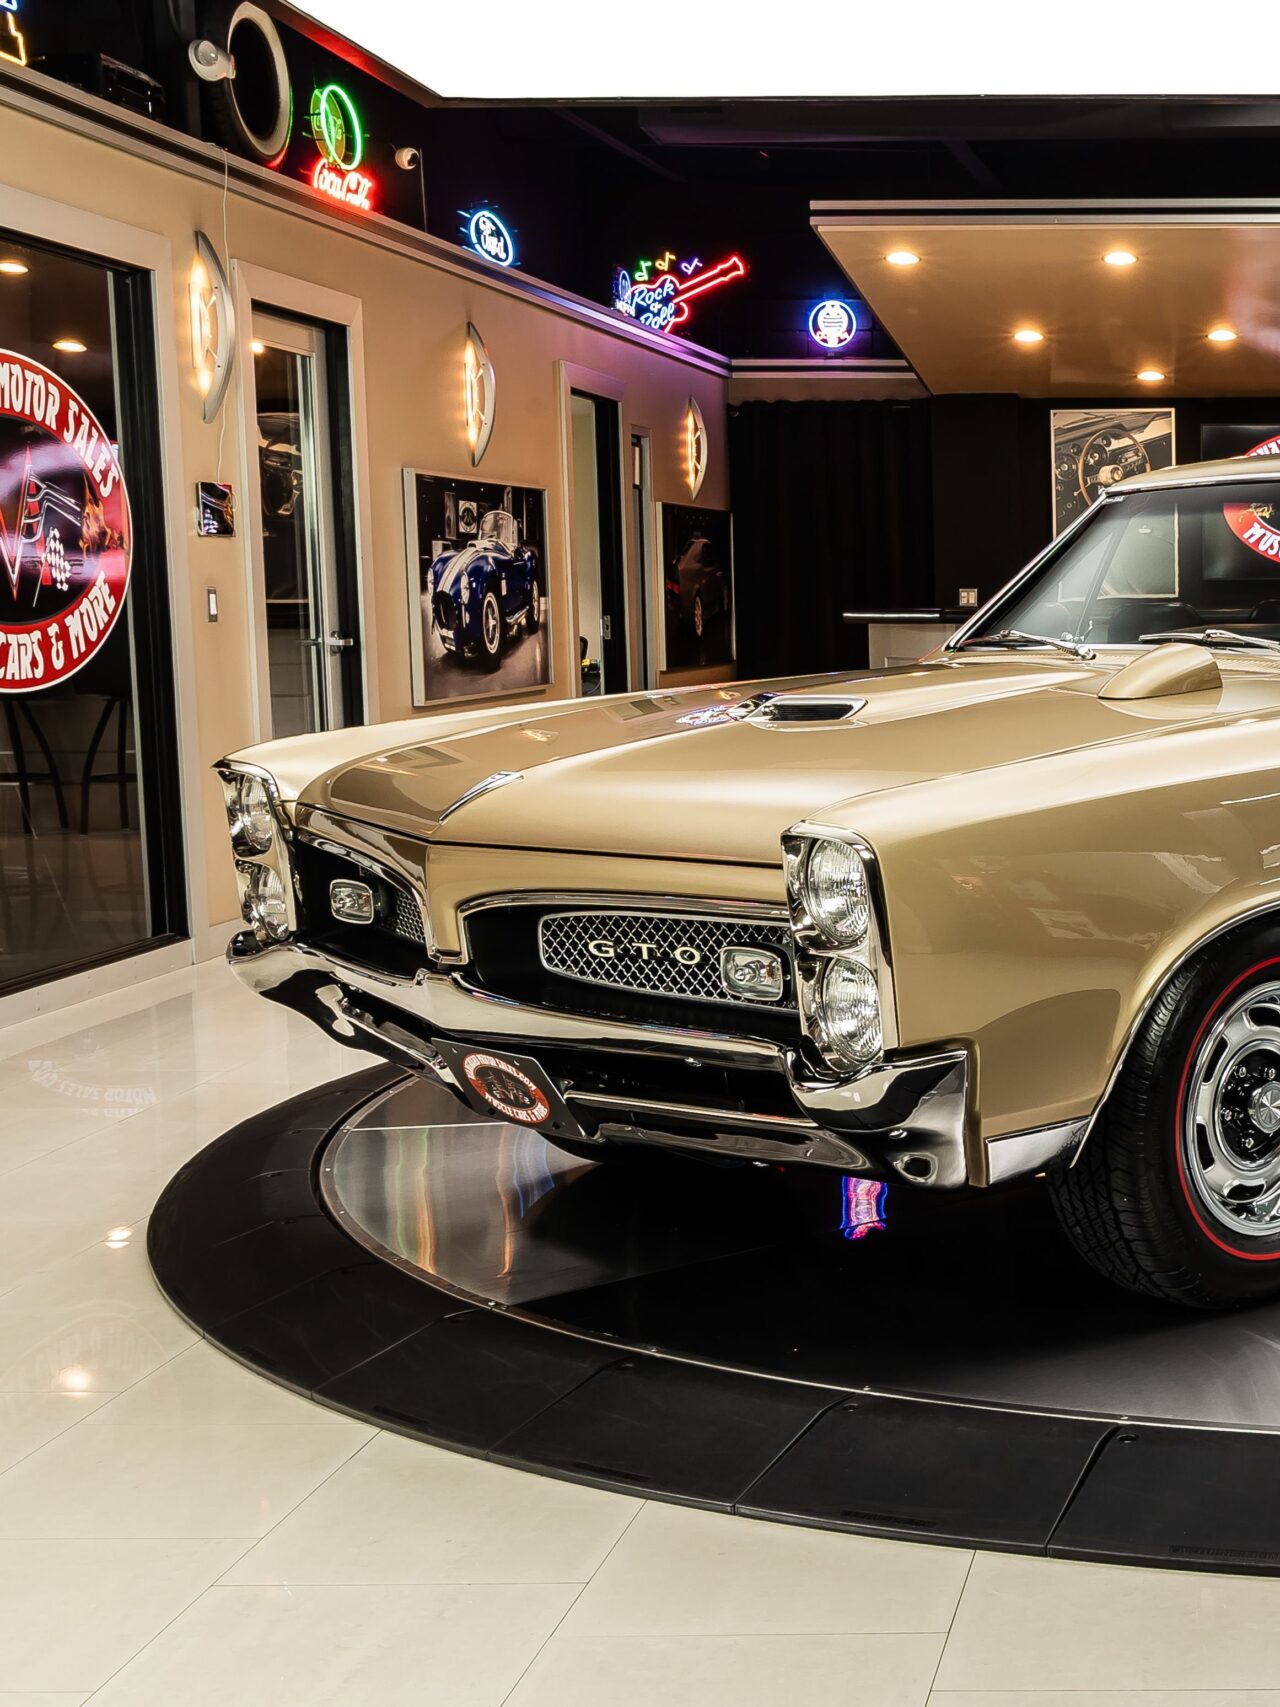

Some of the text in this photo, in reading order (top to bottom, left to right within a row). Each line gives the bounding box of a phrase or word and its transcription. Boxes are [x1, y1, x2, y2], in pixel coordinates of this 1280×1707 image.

[479, 216, 506, 260] Ford
[631, 279, 675, 308] Rock
[63, 398, 119, 498] SALES
[47, 622, 64, 671] &
[64, 570, 116, 660] MORE
